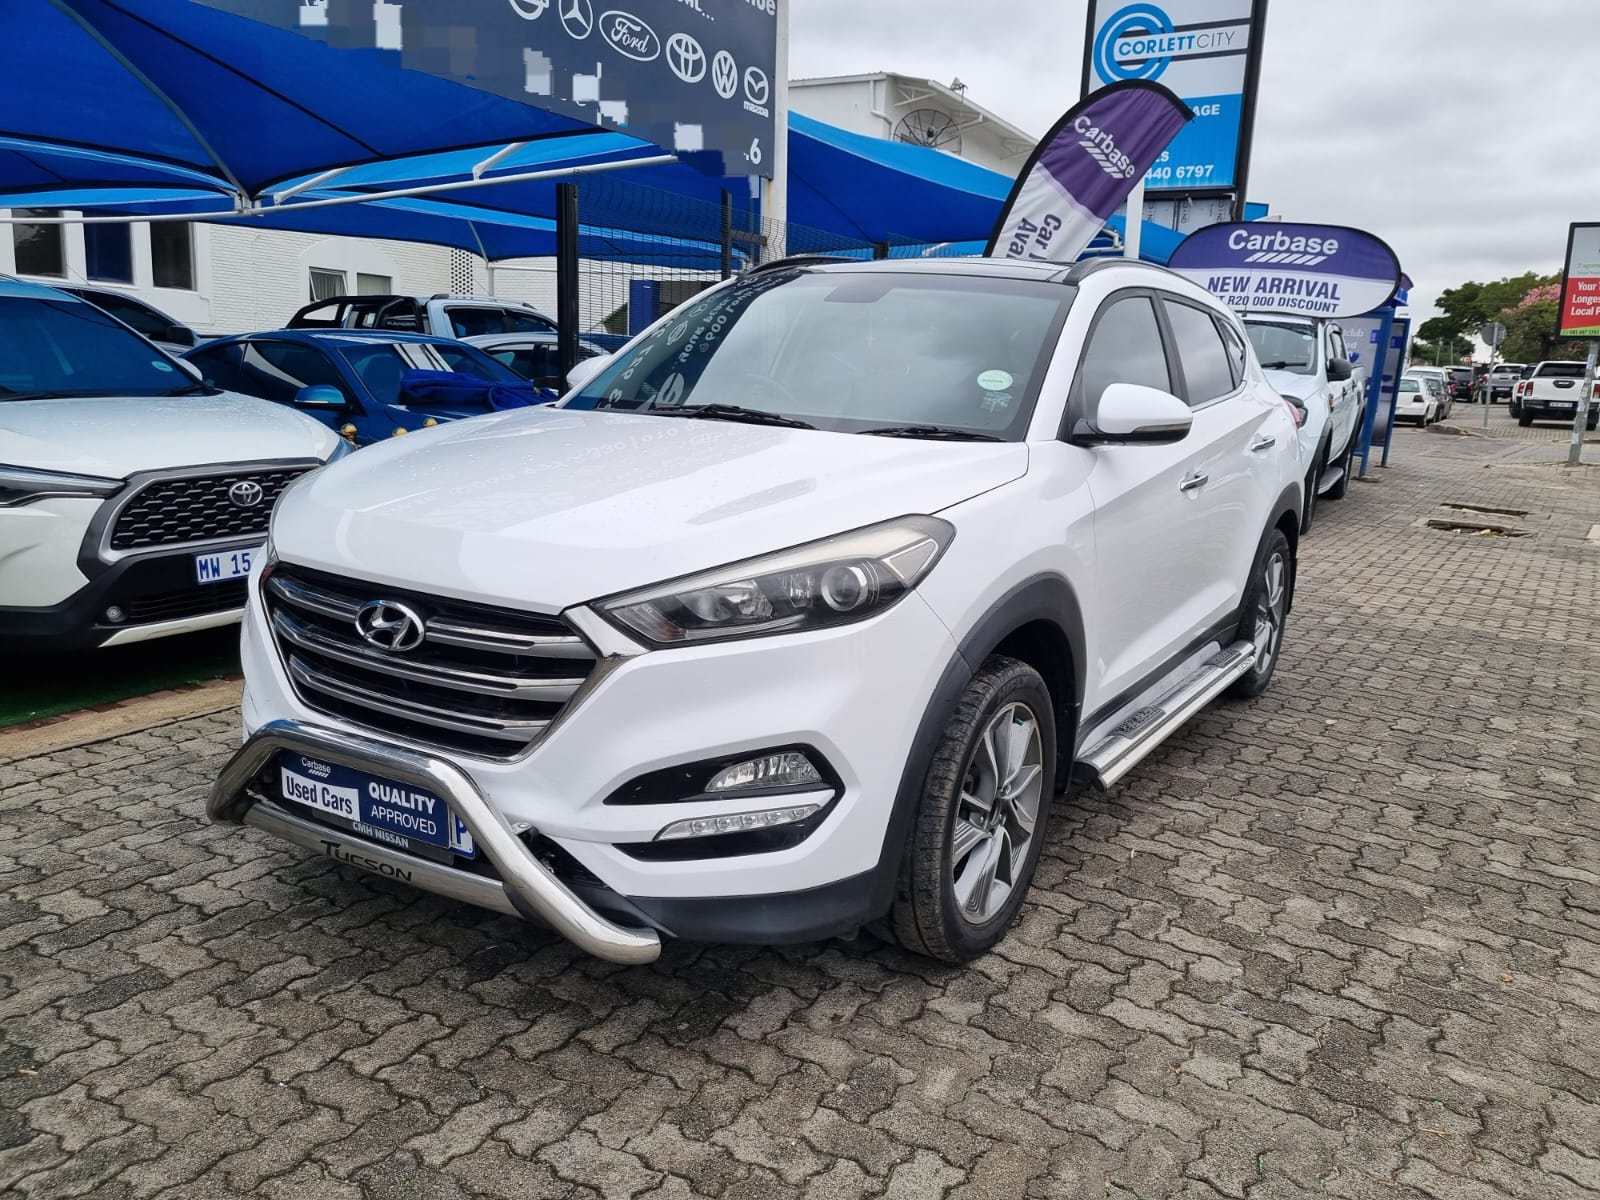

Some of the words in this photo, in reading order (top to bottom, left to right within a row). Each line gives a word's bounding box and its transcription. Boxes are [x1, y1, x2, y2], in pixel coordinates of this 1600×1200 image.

[611, 17, 648, 53] Ford
[1192, 104, 1220, 116] AGE
[1073, 115, 1136, 179] Carbase
[1175, 164, 1214, 178] 6797
[1035, 213, 1062, 250] Car
[1228, 229, 1339, 255] Carbase
[1207, 276, 1251, 293] NEW
[1254, 277, 1341, 300] ARRIVAL
[1577, 281, 1597, 291] Your
[1227, 295, 1249, 306] R20
[1252, 296, 1276, 307] 000
[1277, 297, 1339, 313] DISCOUNT
[1571, 307, 1594, 316] Local
[199, 557, 220, 580] MW
[231, 552, 251, 575] 15
[301, 756, 331, 774] Carbase
[286, 775, 318, 802] Used
[321, 785, 353, 815] Cars
[368, 782, 436, 815] QUALITY
[370, 804, 437, 836] APPROVED
[352, 820, 373, 838] CMH
[373, 827, 410, 849] NISSAN
